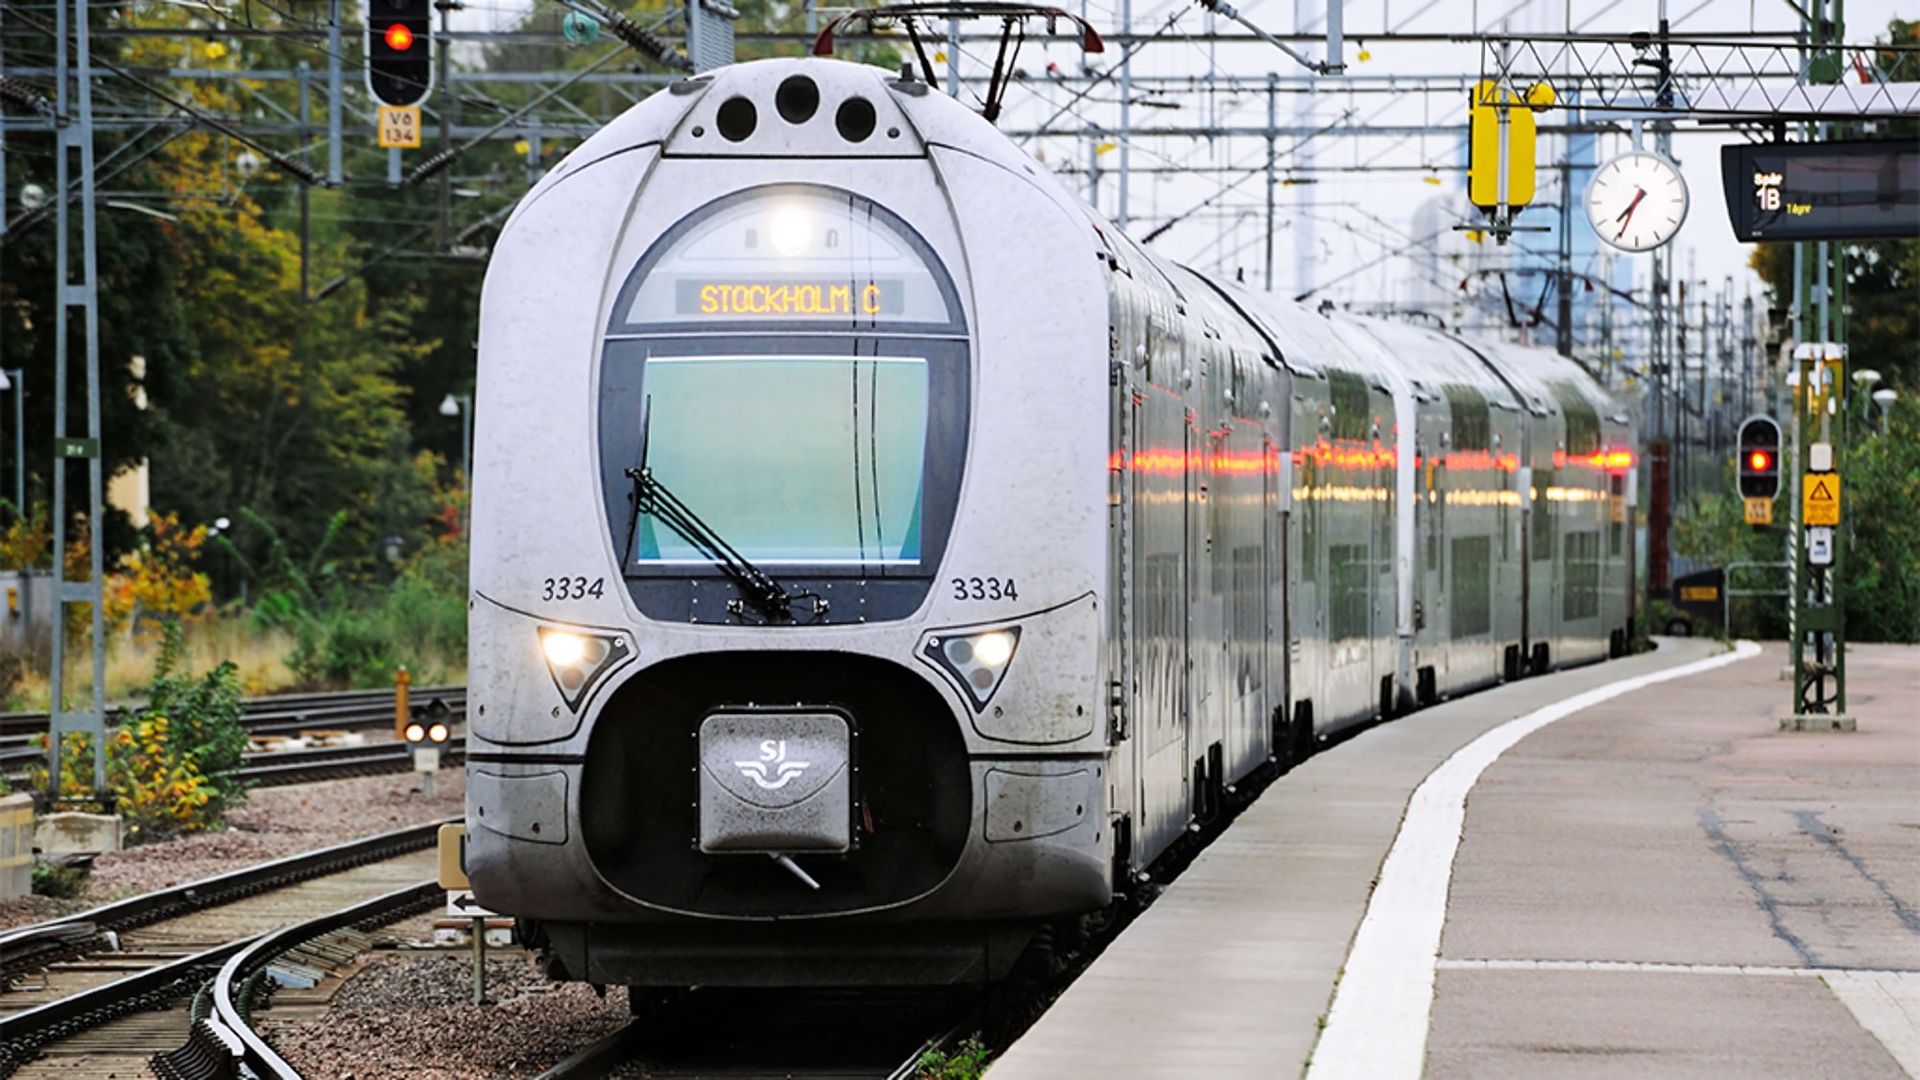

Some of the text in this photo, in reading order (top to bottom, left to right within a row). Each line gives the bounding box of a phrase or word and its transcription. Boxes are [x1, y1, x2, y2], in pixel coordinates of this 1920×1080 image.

[1756, 186, 1781, 211] 1B
[701, 284, 881, 314] STOCKHOLM C
[542, 577, 604, 601] 3334
[951, 577, 1018, 601] 3334
[759, 739, 786, 762] SJ
